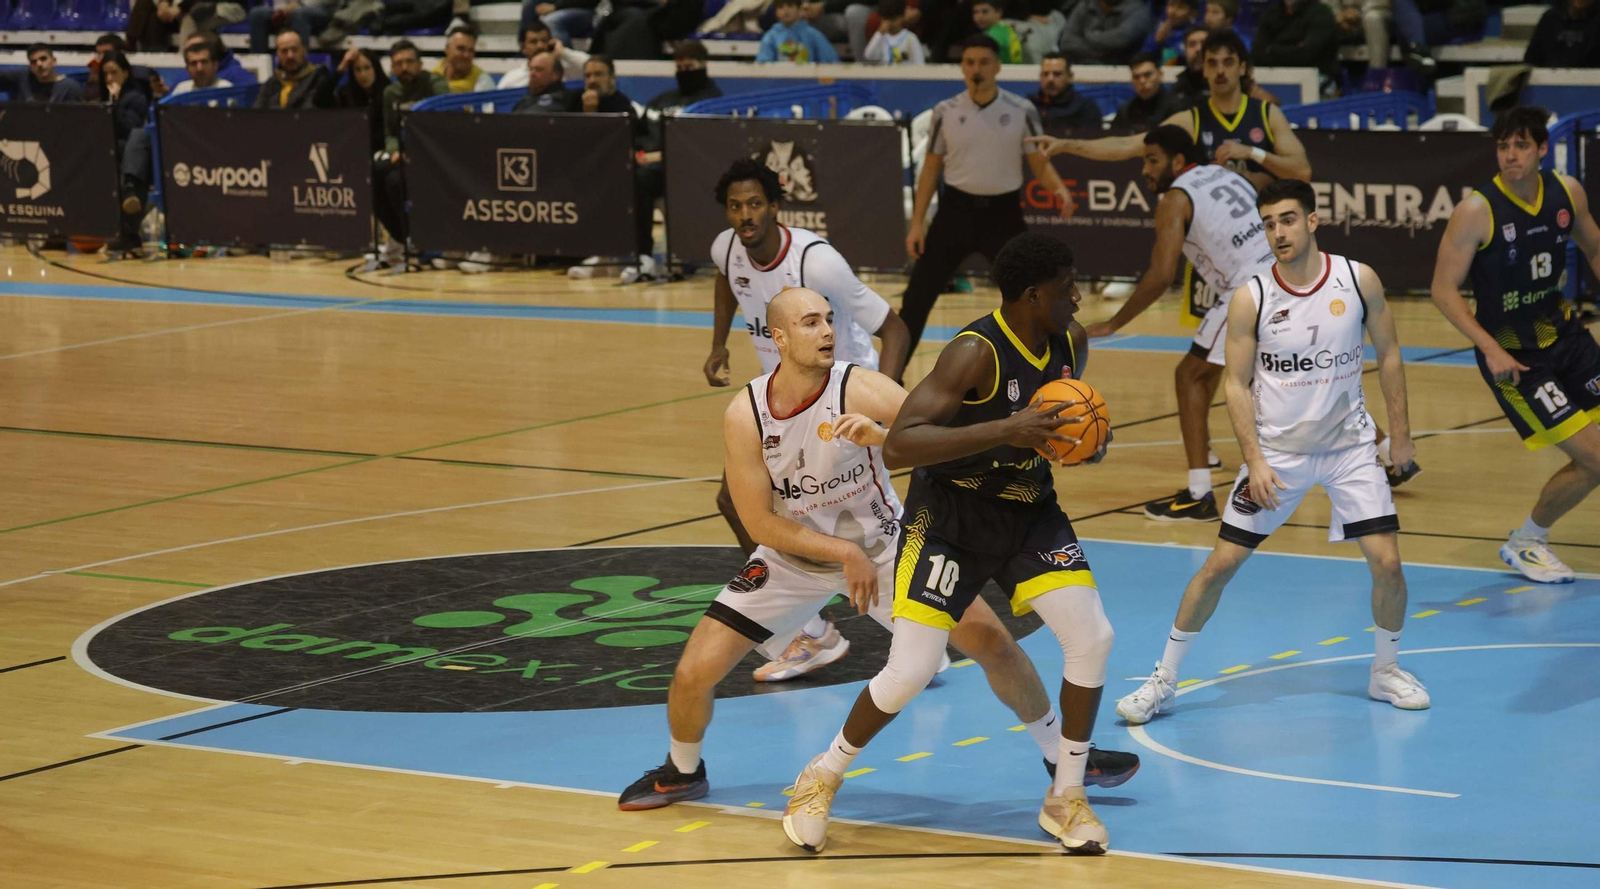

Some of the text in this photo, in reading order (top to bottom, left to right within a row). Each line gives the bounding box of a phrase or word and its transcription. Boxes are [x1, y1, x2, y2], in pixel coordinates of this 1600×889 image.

[192, 159, 267, 195] surpool
[504, 156, 530, 185] K3
[9, 203, 65, 217] ESQUINA
[293, 186, 356, 208] LABOR
[463, 199, 579, 225] ASESORES
[1530, 252, 1553, 280] 13
[1307, 325, 1319, 346] 7
[1534, 381, 1568, 413] 13
[925, 553, 960, 598] 10
